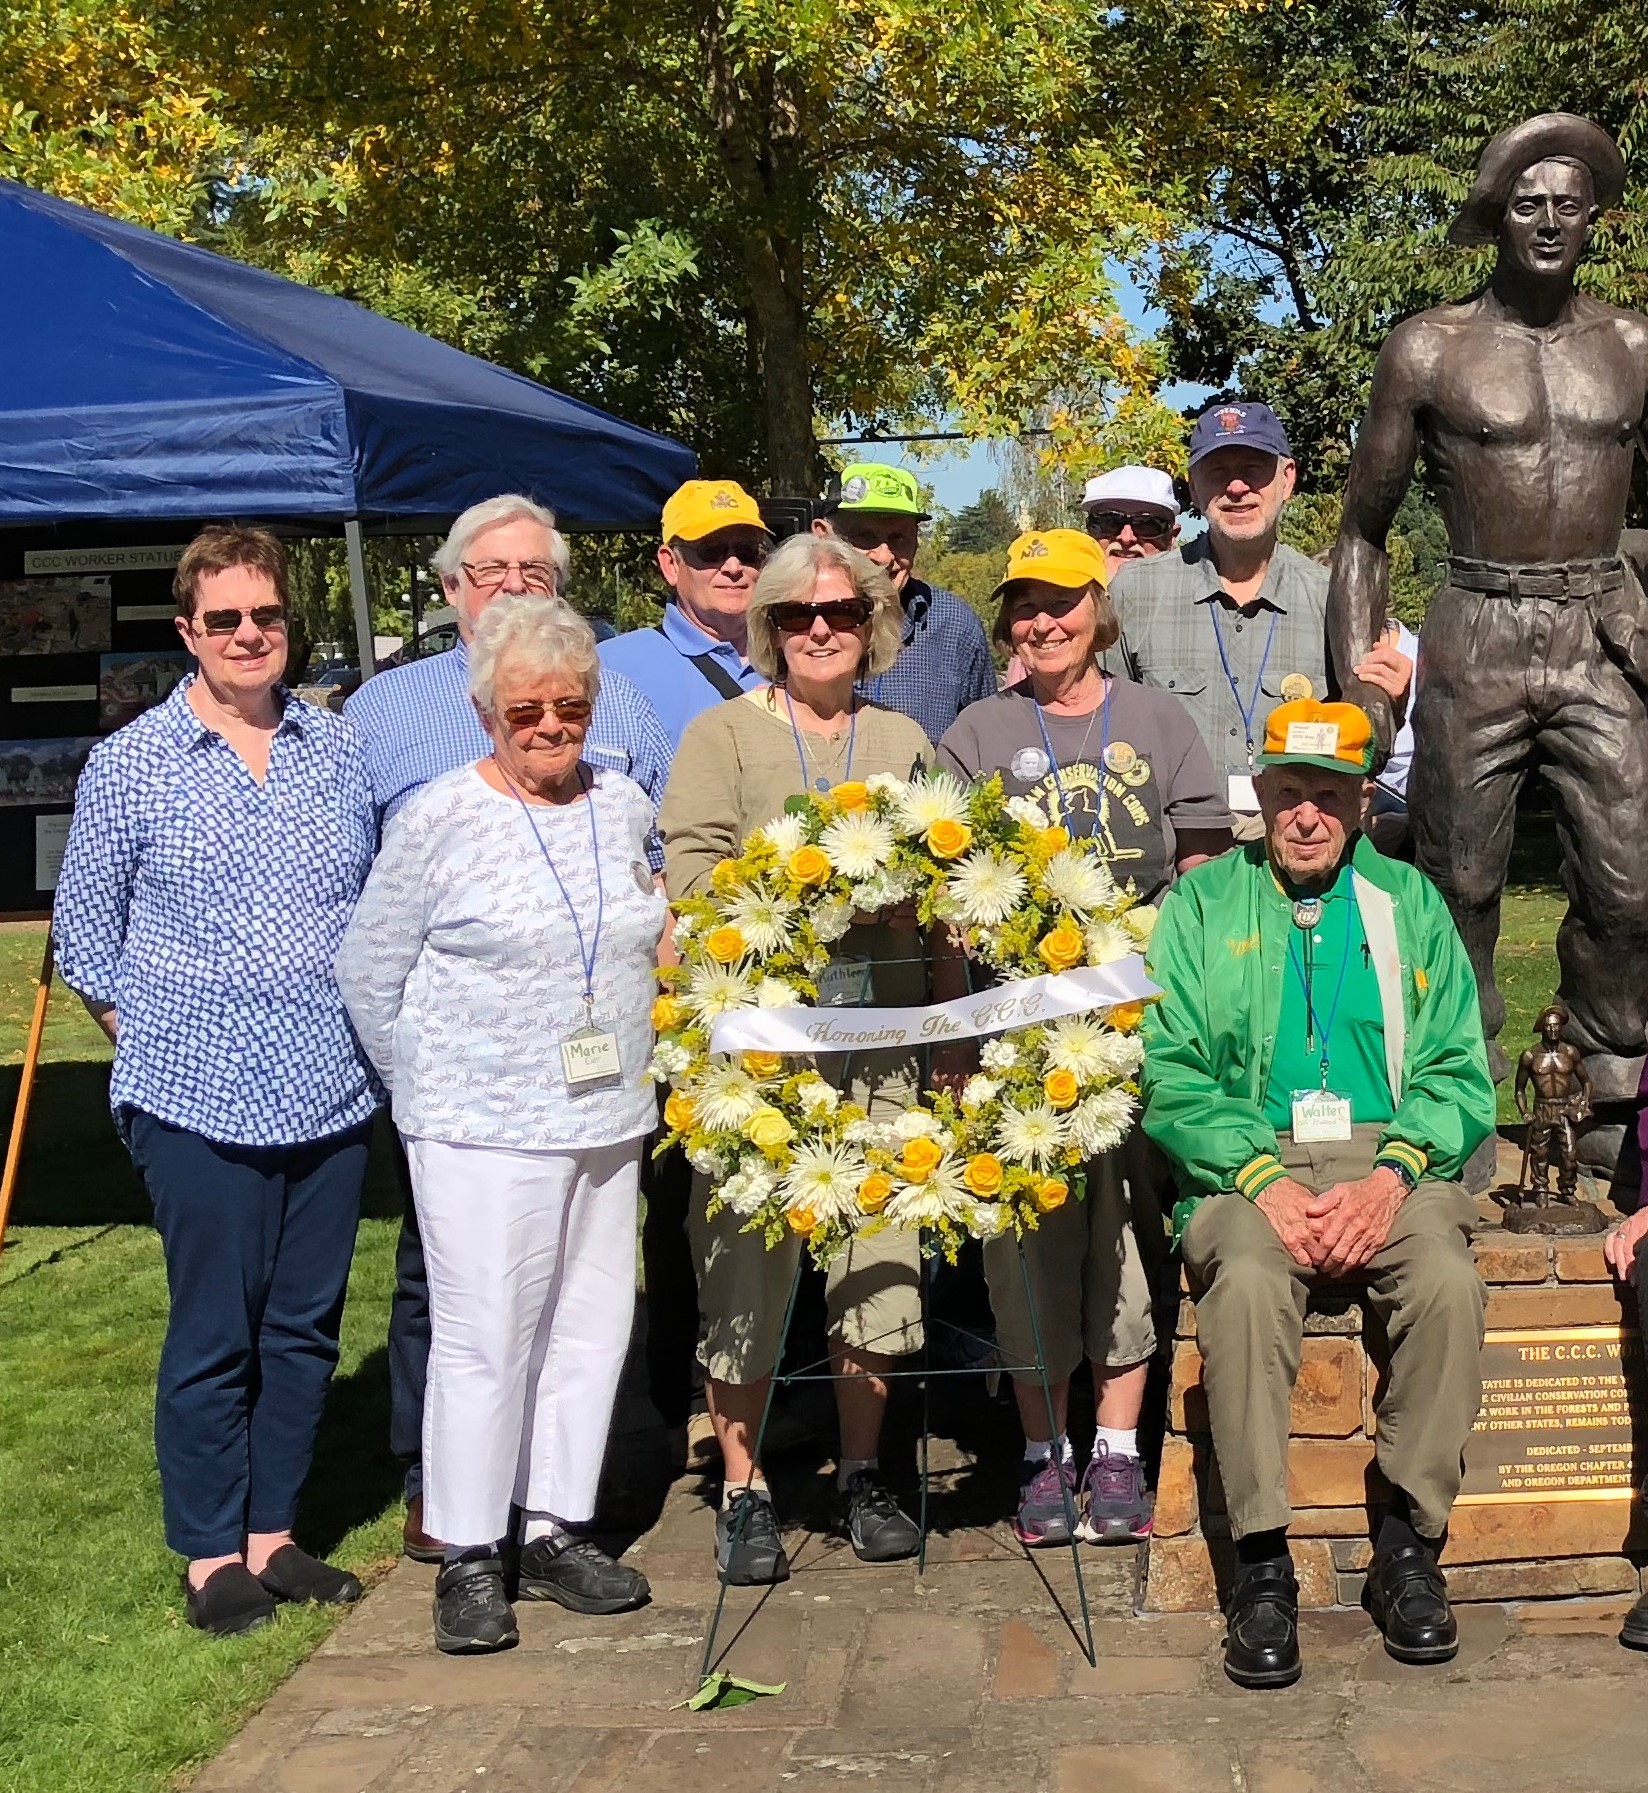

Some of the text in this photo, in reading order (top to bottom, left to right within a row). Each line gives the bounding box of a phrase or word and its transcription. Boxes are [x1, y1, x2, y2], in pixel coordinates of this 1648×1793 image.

[32, 550, 181, 569] CCC WORKER STATUE
[1043, 763, 1127, 799] CONSERVAION
[1122, 793, 1150, 827] CORPS
[805, 1017, 907, 1045] Honoring
[919, 1013, 962, 1037] The
[570, 1042, 610, 1059] Marie
[1518, 1346, 1551, 1361] THE
[1554, 1344, 1602, 1359] C.C.C.
[1481, 1379, 1512, 1390] TATUE
[1514, 1378, 1524, 1388] IS
[1525, 1376, 1580, 1389] DEDICATED
[1581, 1376, 1596, 1386] TO
[1598, 1375, 1618, 1385] THE
[1490, 1392, 1533, 1403] CIVILIAN
[1535, 1389, 1608, 1402] CONSERVATION
[1489, 1406, 1519, 1417] WORK
[1521, 1406, 1532, 1416] IN
[1534, 1405, 1555, 1415] THE
[1556, 1403, 1599, 1414] FORESTS
[1600, 1402, 1621, 1413] AND
[1470, 1421, 1488, 1431] NY
[1489, 1419, 1523, 1430] OTHER
[1525, 1418, 1564, 1430] STATES,
[1565, 1416, 1609, 1428] REMAINS
[1610, 1416, 1632, 1427] TOD
[1526, 1444, 1581, 1456] DEDICATED
[1588, 1443, 1633, 1454] SEPTEMB
[1498, 1465, 1513, 1475] BY
[1514, 1464, 1535, 1474] THE
[1536, 1462, 1578, 1474] OREGON
[1580, 1460, 1625, 1472] CHAPTER
[1501, 1473, 1632, 1488] AND OREGON DEPARTMENT
